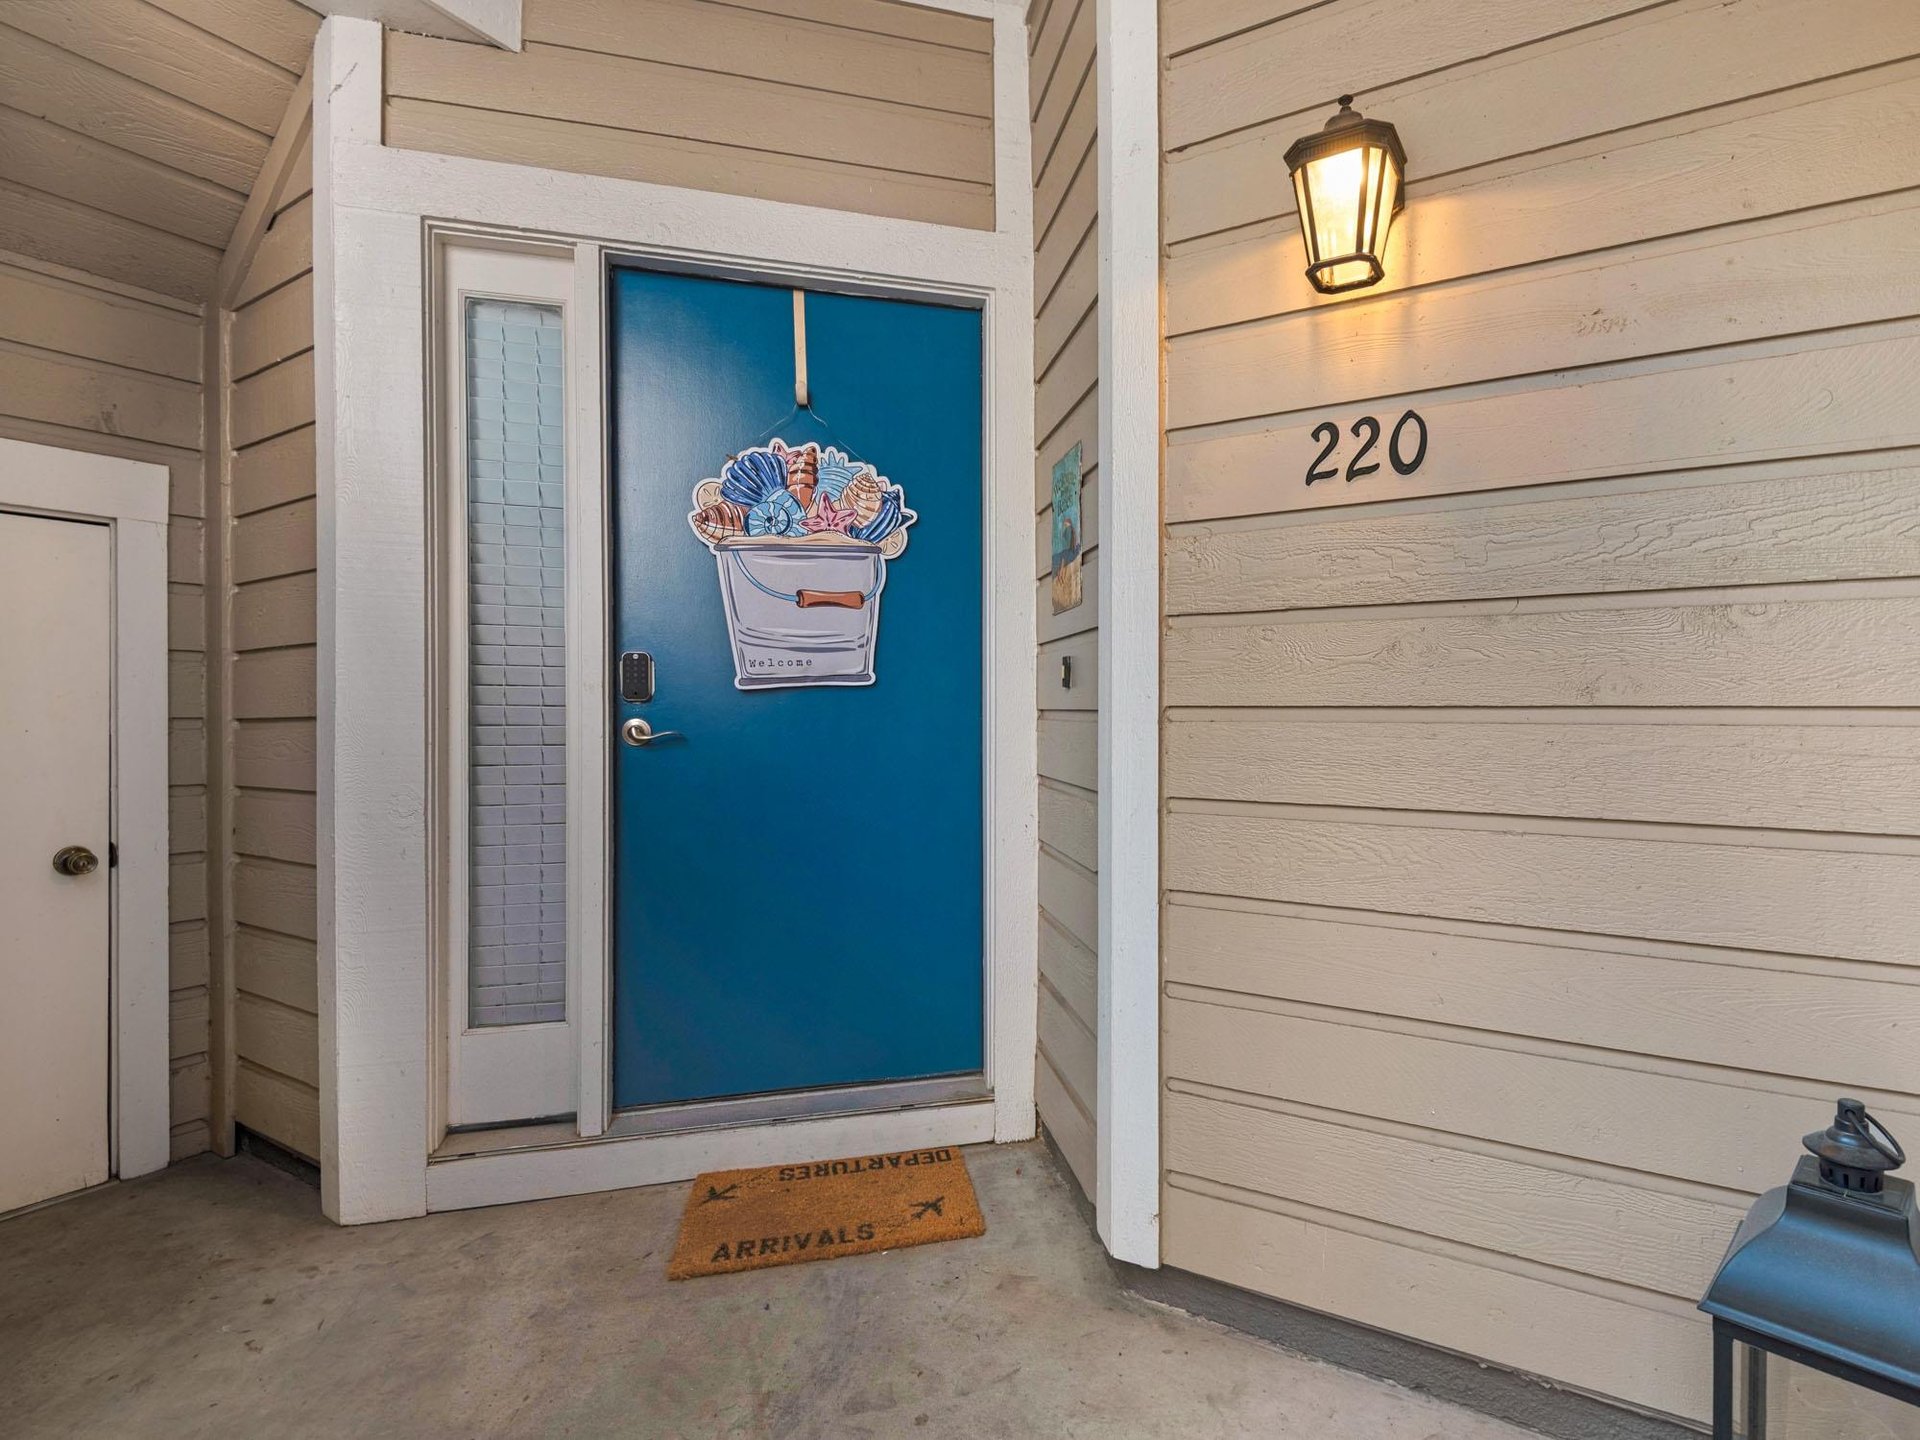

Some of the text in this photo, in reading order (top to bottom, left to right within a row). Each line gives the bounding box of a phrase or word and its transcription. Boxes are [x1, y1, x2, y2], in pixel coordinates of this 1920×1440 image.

[1305, 409, 1428, 487] 220
[748, 658, 813, 669] Welcome
[778, 1149, 952, 1182] DEPARTURES
[711, 1222, 876, 1263] ARRIVALS
